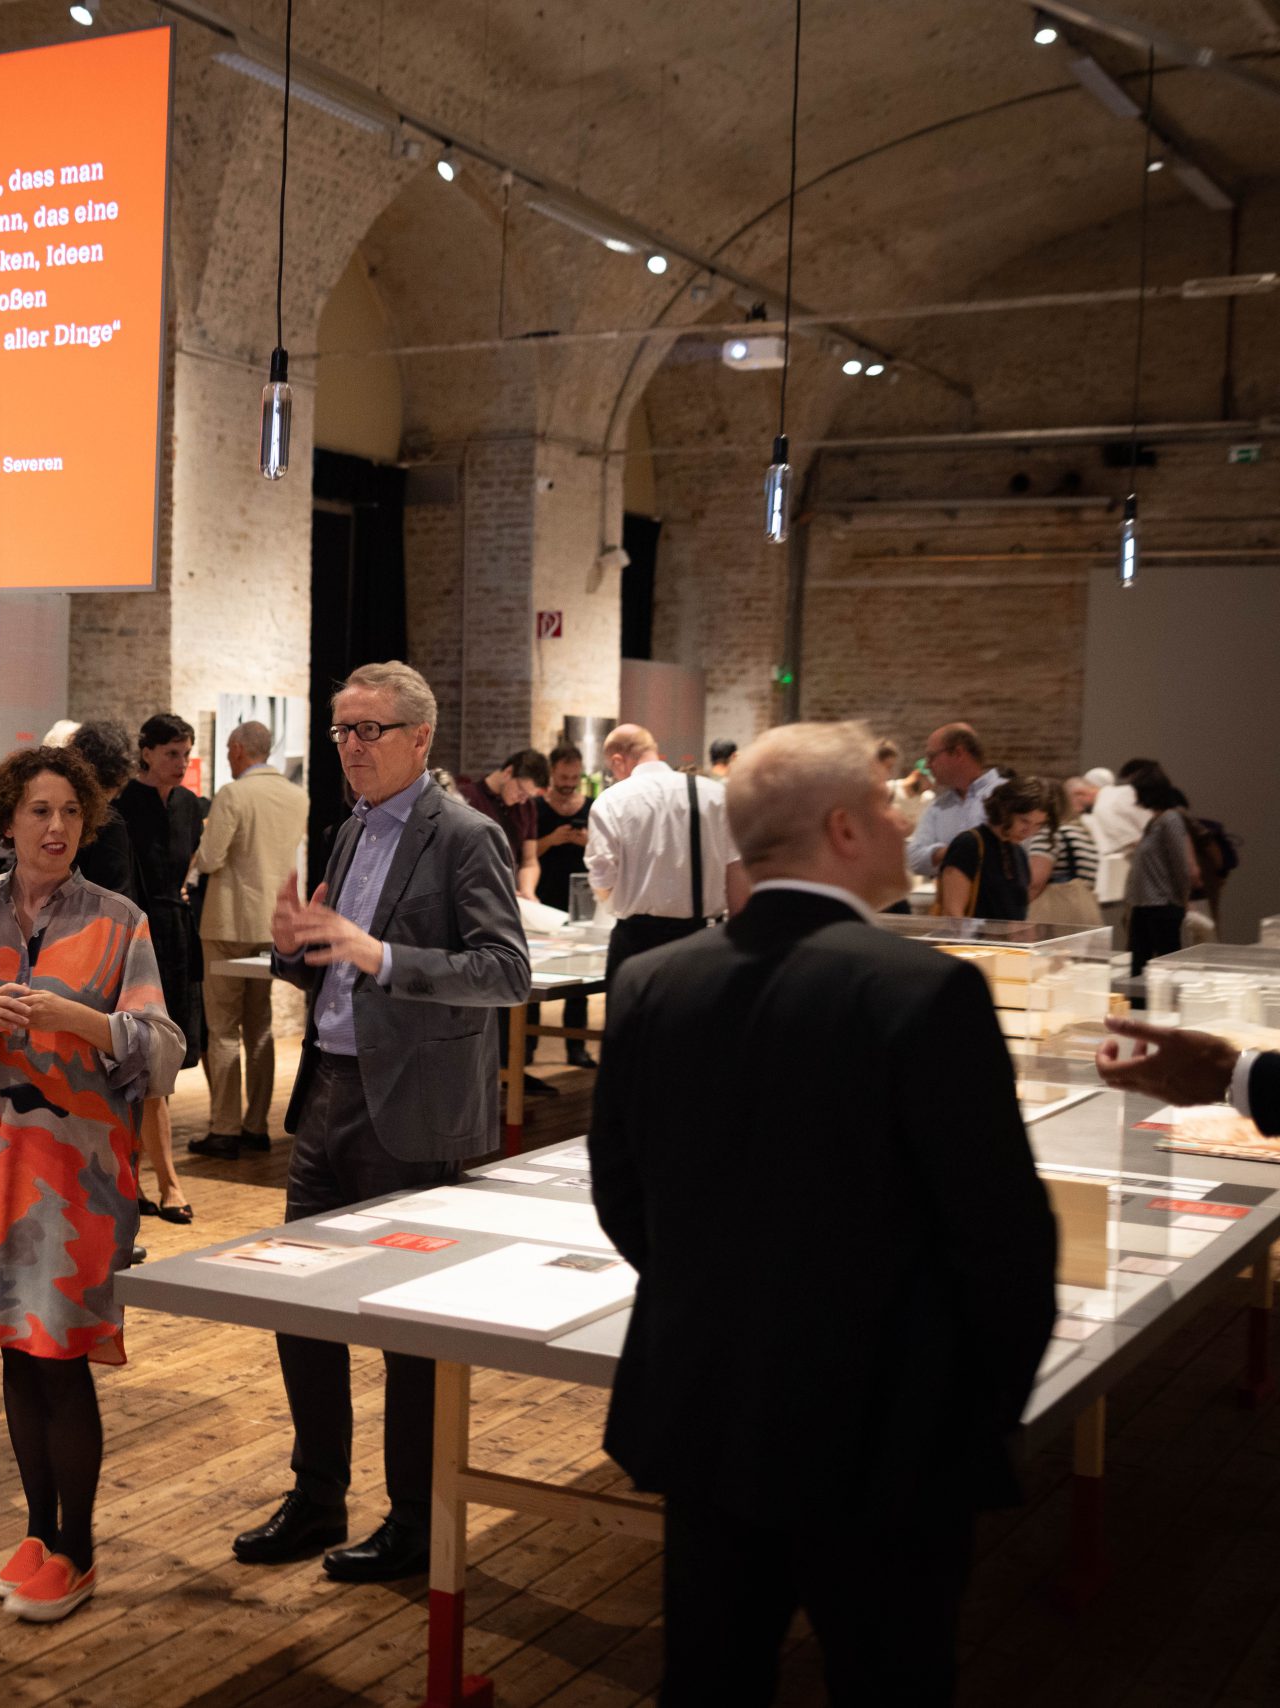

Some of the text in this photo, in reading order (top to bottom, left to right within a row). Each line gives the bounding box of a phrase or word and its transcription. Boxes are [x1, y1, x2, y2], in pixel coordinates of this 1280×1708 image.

[7, 167, 56, 192] dass
[59, 161, 105, 186] man
[32, 204, 70, 229] das
[73, 199, 120, 224] eine
[45, 242, 105, 268] Ideen
[3, 326, 51, 351] aller
[1, 455, 64, 474] Severen
